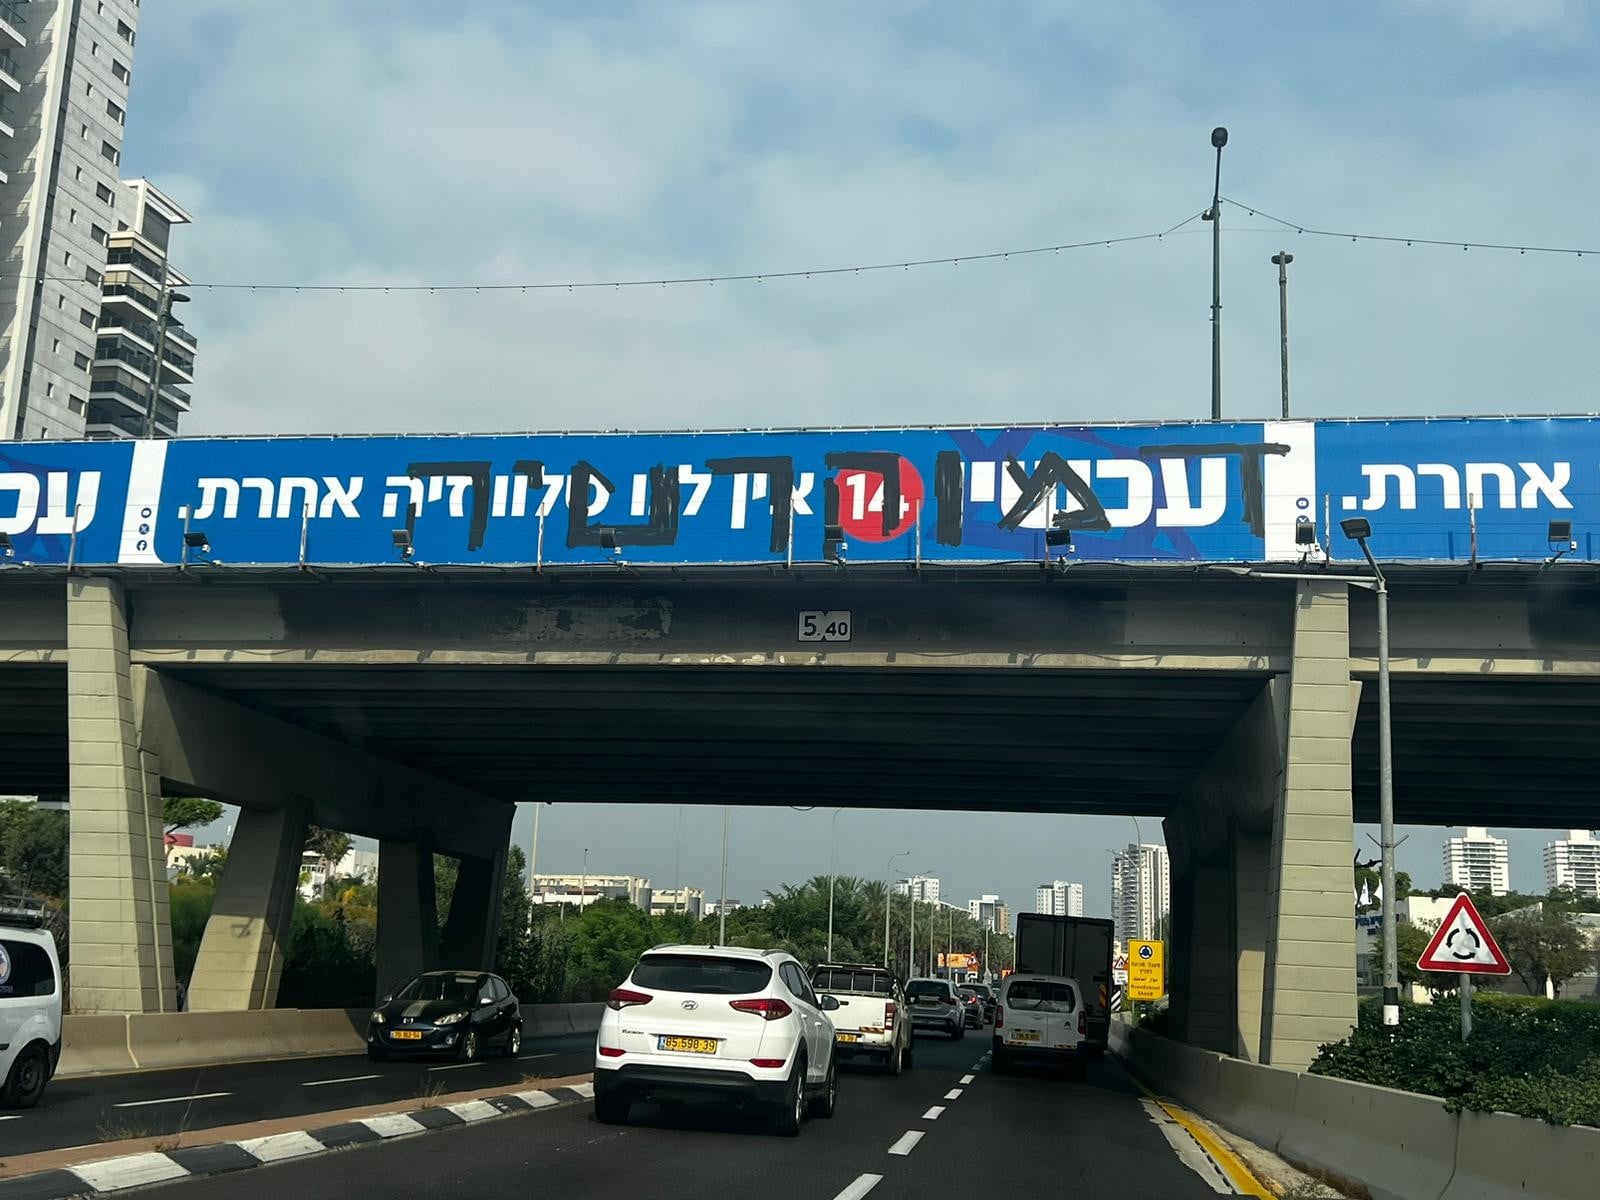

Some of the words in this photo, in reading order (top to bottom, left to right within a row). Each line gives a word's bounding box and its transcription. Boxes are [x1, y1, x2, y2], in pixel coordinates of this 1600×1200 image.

[178, 476, 364, 519] אחרת.
[630, 464, 712, 516] לו
[939, 457, 1226, 529] עכשי
[1342, 461, 1574, 510] אחרת.
[803, 615, 848, 637] 5.40
